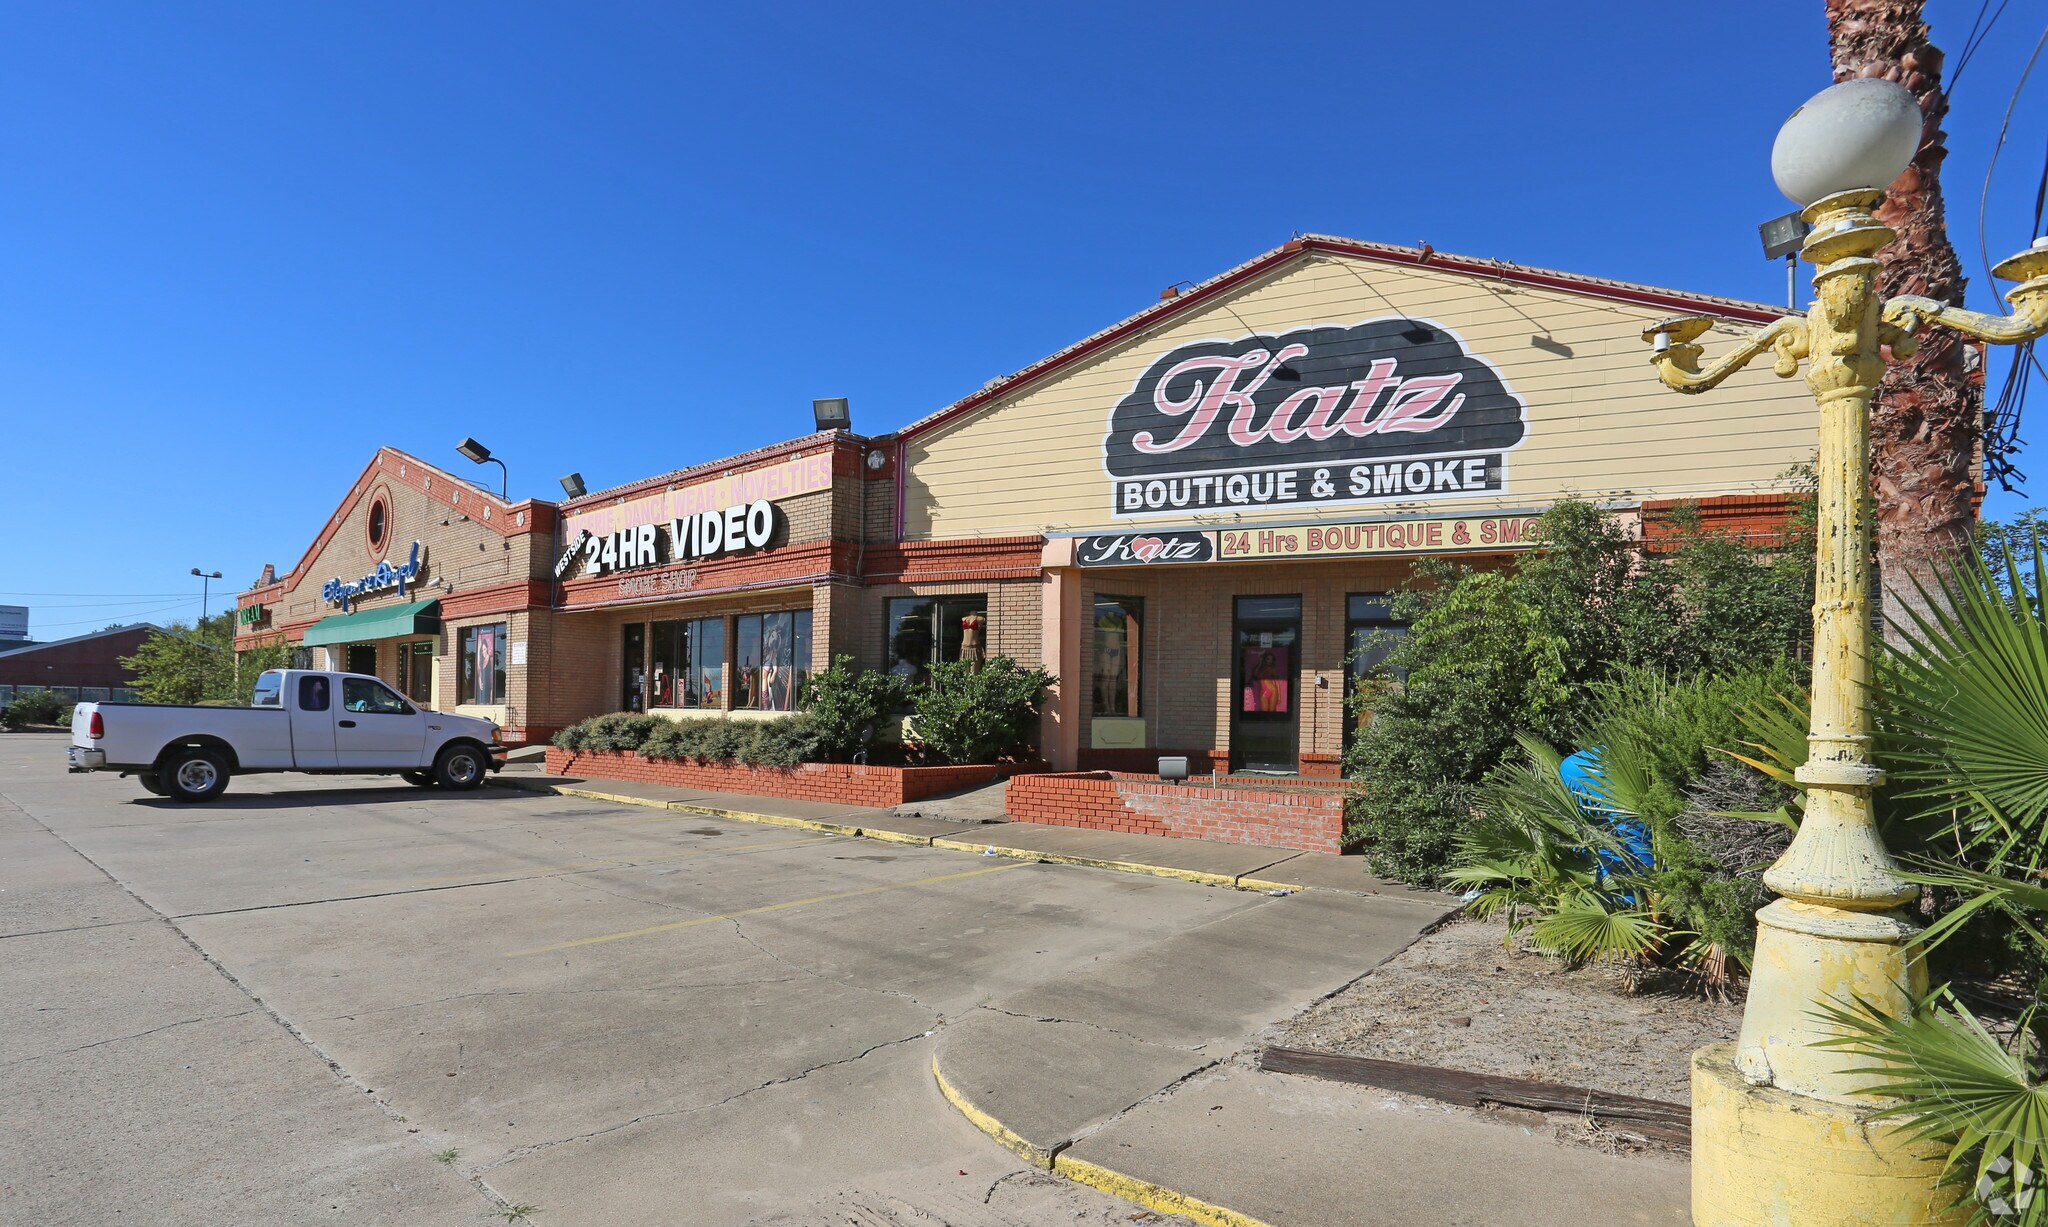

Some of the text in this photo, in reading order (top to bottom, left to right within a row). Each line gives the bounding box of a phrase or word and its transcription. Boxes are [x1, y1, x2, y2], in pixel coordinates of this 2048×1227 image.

[1133, 343, 1466, 454] Katz
[625, 496, 669, 527] DANCE
[674, 484, 716, 518] WEAR
[730, 457, 832, 505] NOVELTIES
[1123, 458, 1487, 510] BOUTIQUE & SMOKE
[554, 529, 587, 578] WESTSIDE
[585, 499, 774, 575] 24HR VIDEO
[1083, 532, 1201, 564] Katz
[1222, 518, 1543, 556] 24 Hrs BOUTIQUE & SMO
[617, 568, 697, 597] SMOKE SHOP
